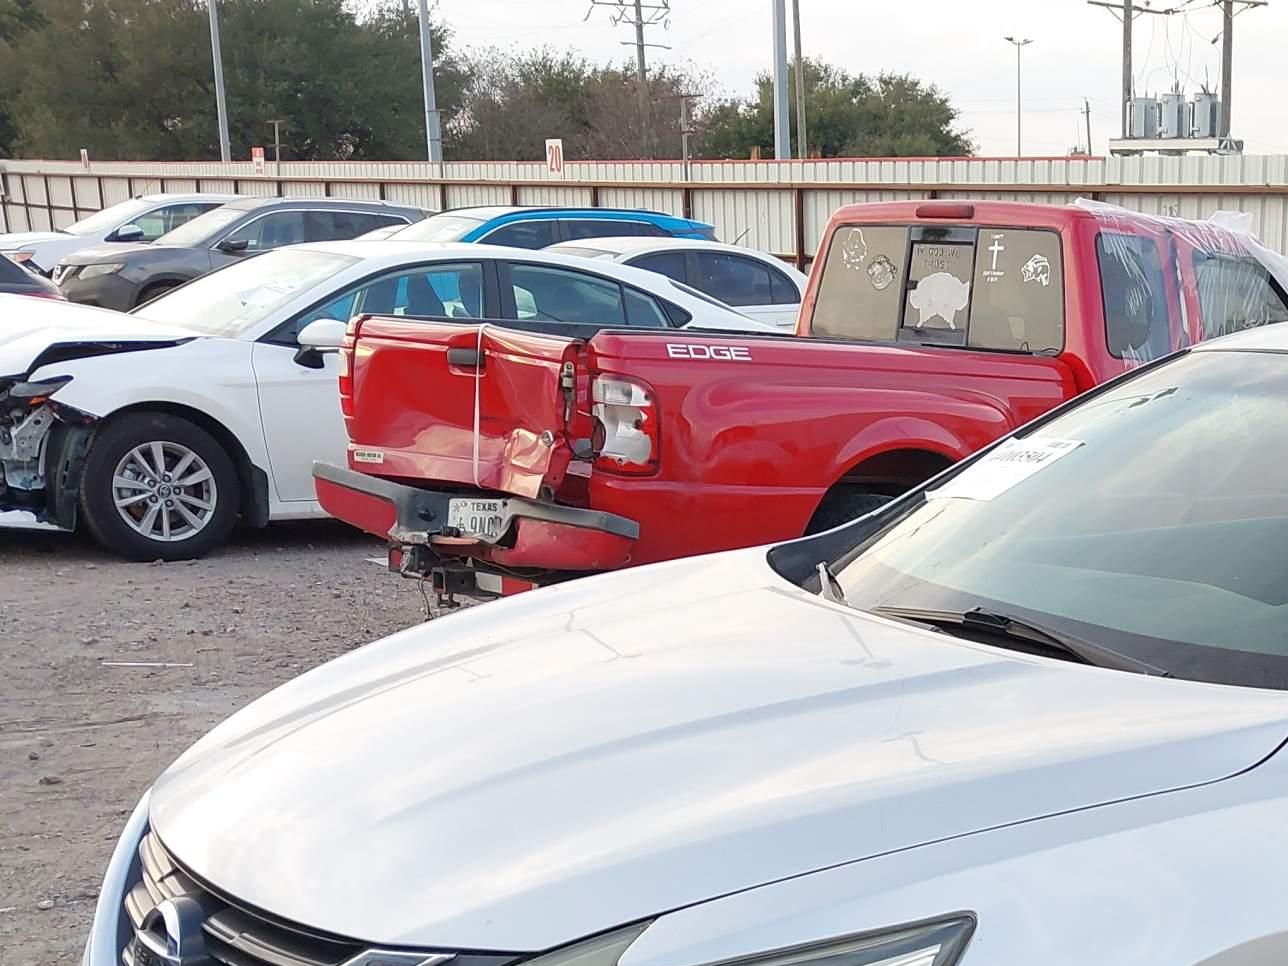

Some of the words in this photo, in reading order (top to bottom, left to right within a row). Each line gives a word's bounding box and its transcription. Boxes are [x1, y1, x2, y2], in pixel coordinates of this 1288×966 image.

[549, 145, 561, 172] 20
[666, 343, 752, 360] EDGE
[470, 502, 498, 512] TEXAS
